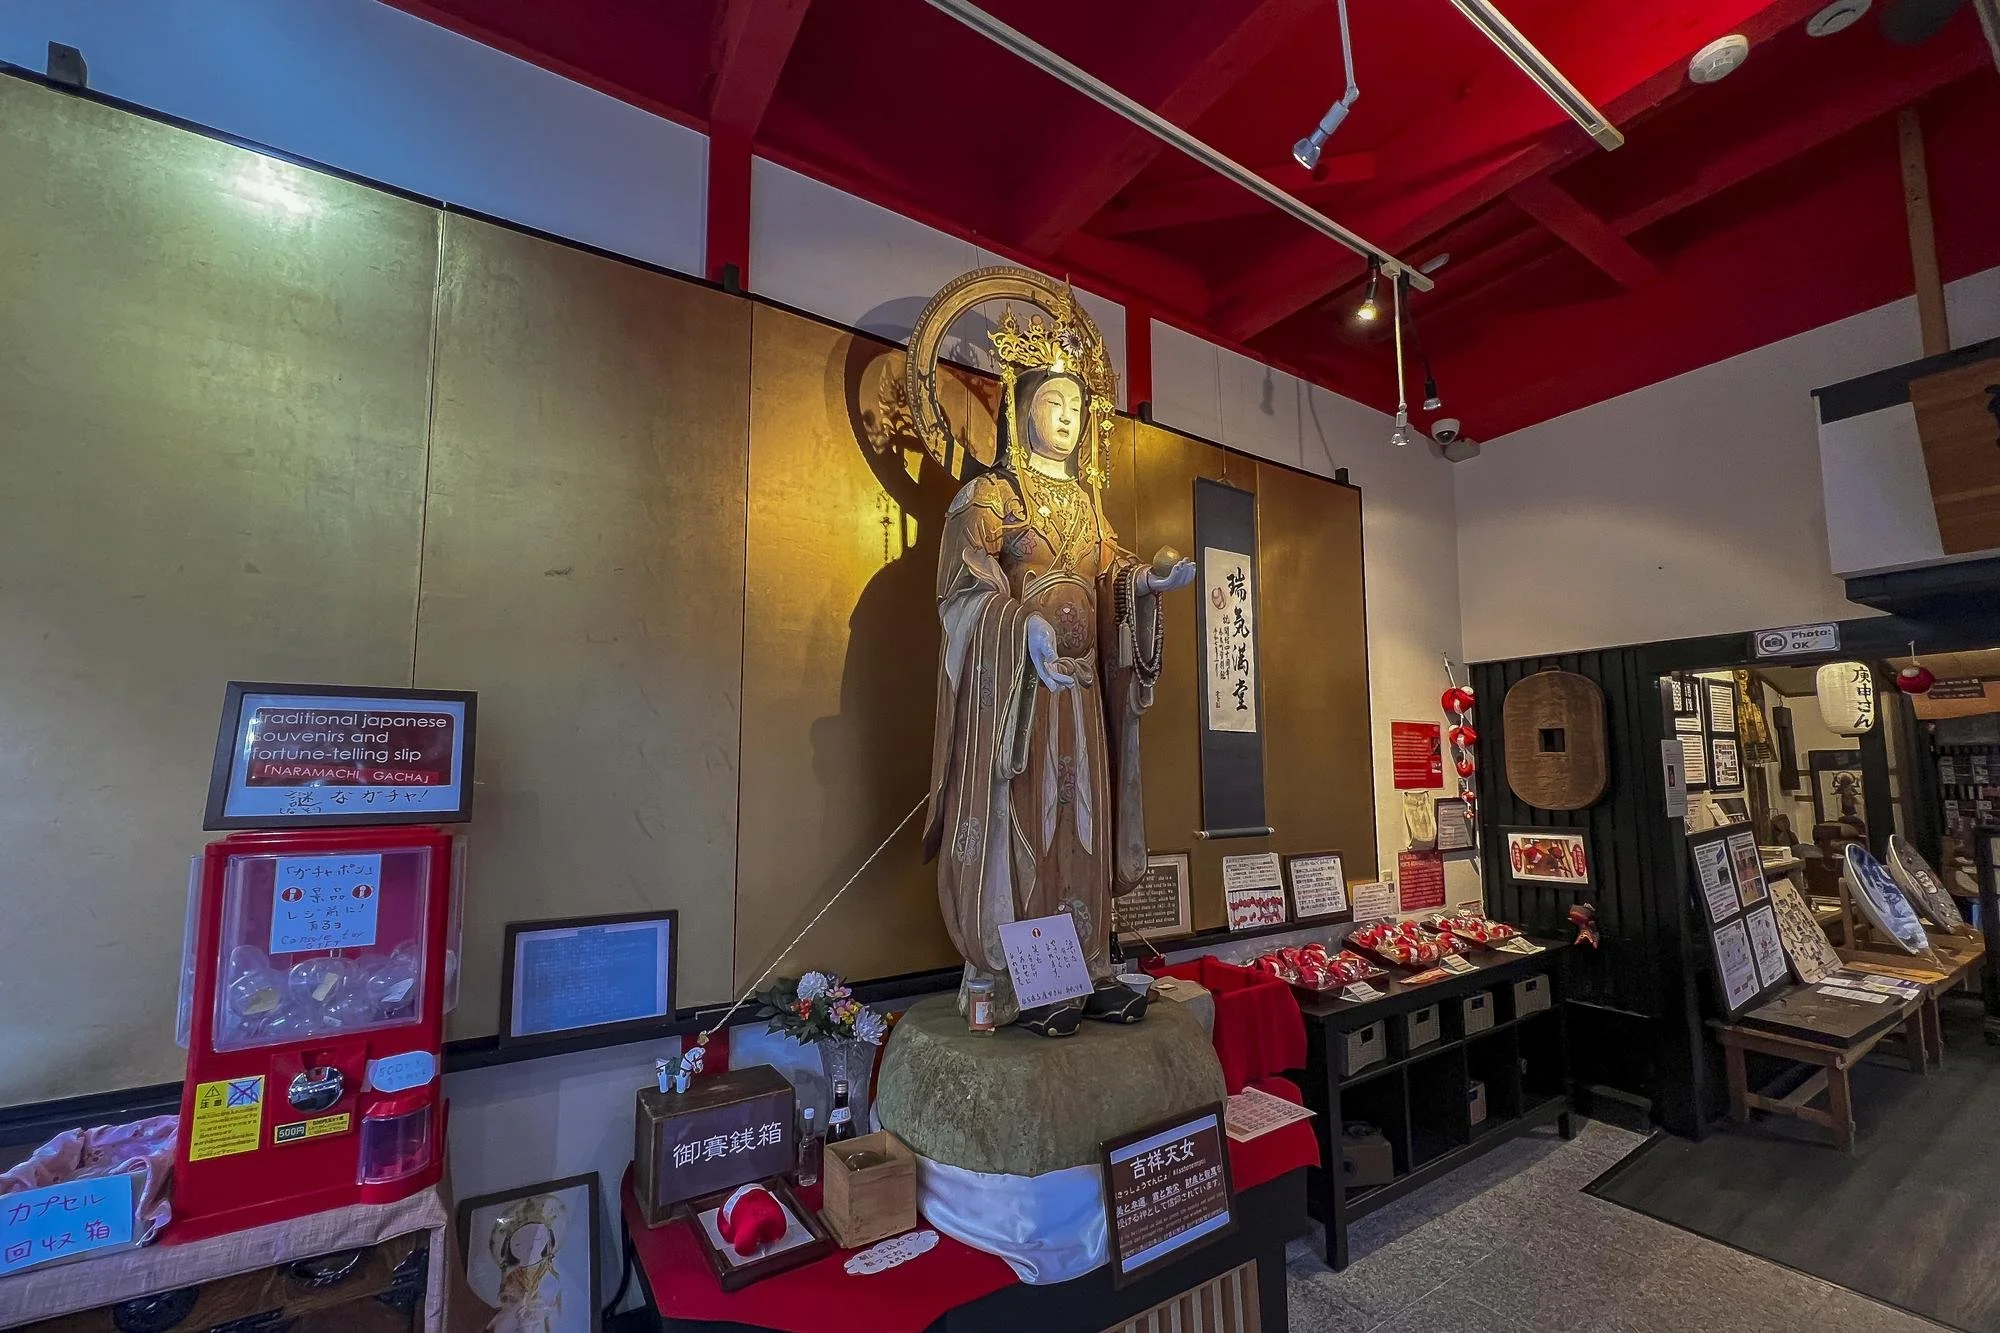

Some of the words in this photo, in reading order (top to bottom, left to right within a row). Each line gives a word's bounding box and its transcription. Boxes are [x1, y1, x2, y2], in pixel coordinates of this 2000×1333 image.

[1792, 641, 1809, 649] OK
[1851, 666, 1873, 728] 庚申さん
[259, 712, 358, 726] traditional
[361, 714, 447, 729] japanese
[350, 731, 389, 743] and
[252, 747, 389, 763] fortune-telling
[394, 748, 421, 763] slip
[278, 1125, 304, 1138] 500円
[672, 1121, 783, 1169] 御賽銭箱
[1130, 1138, 1195, 1179] 吉祥天女
[8, 1194, 106, 1226] カプセル
